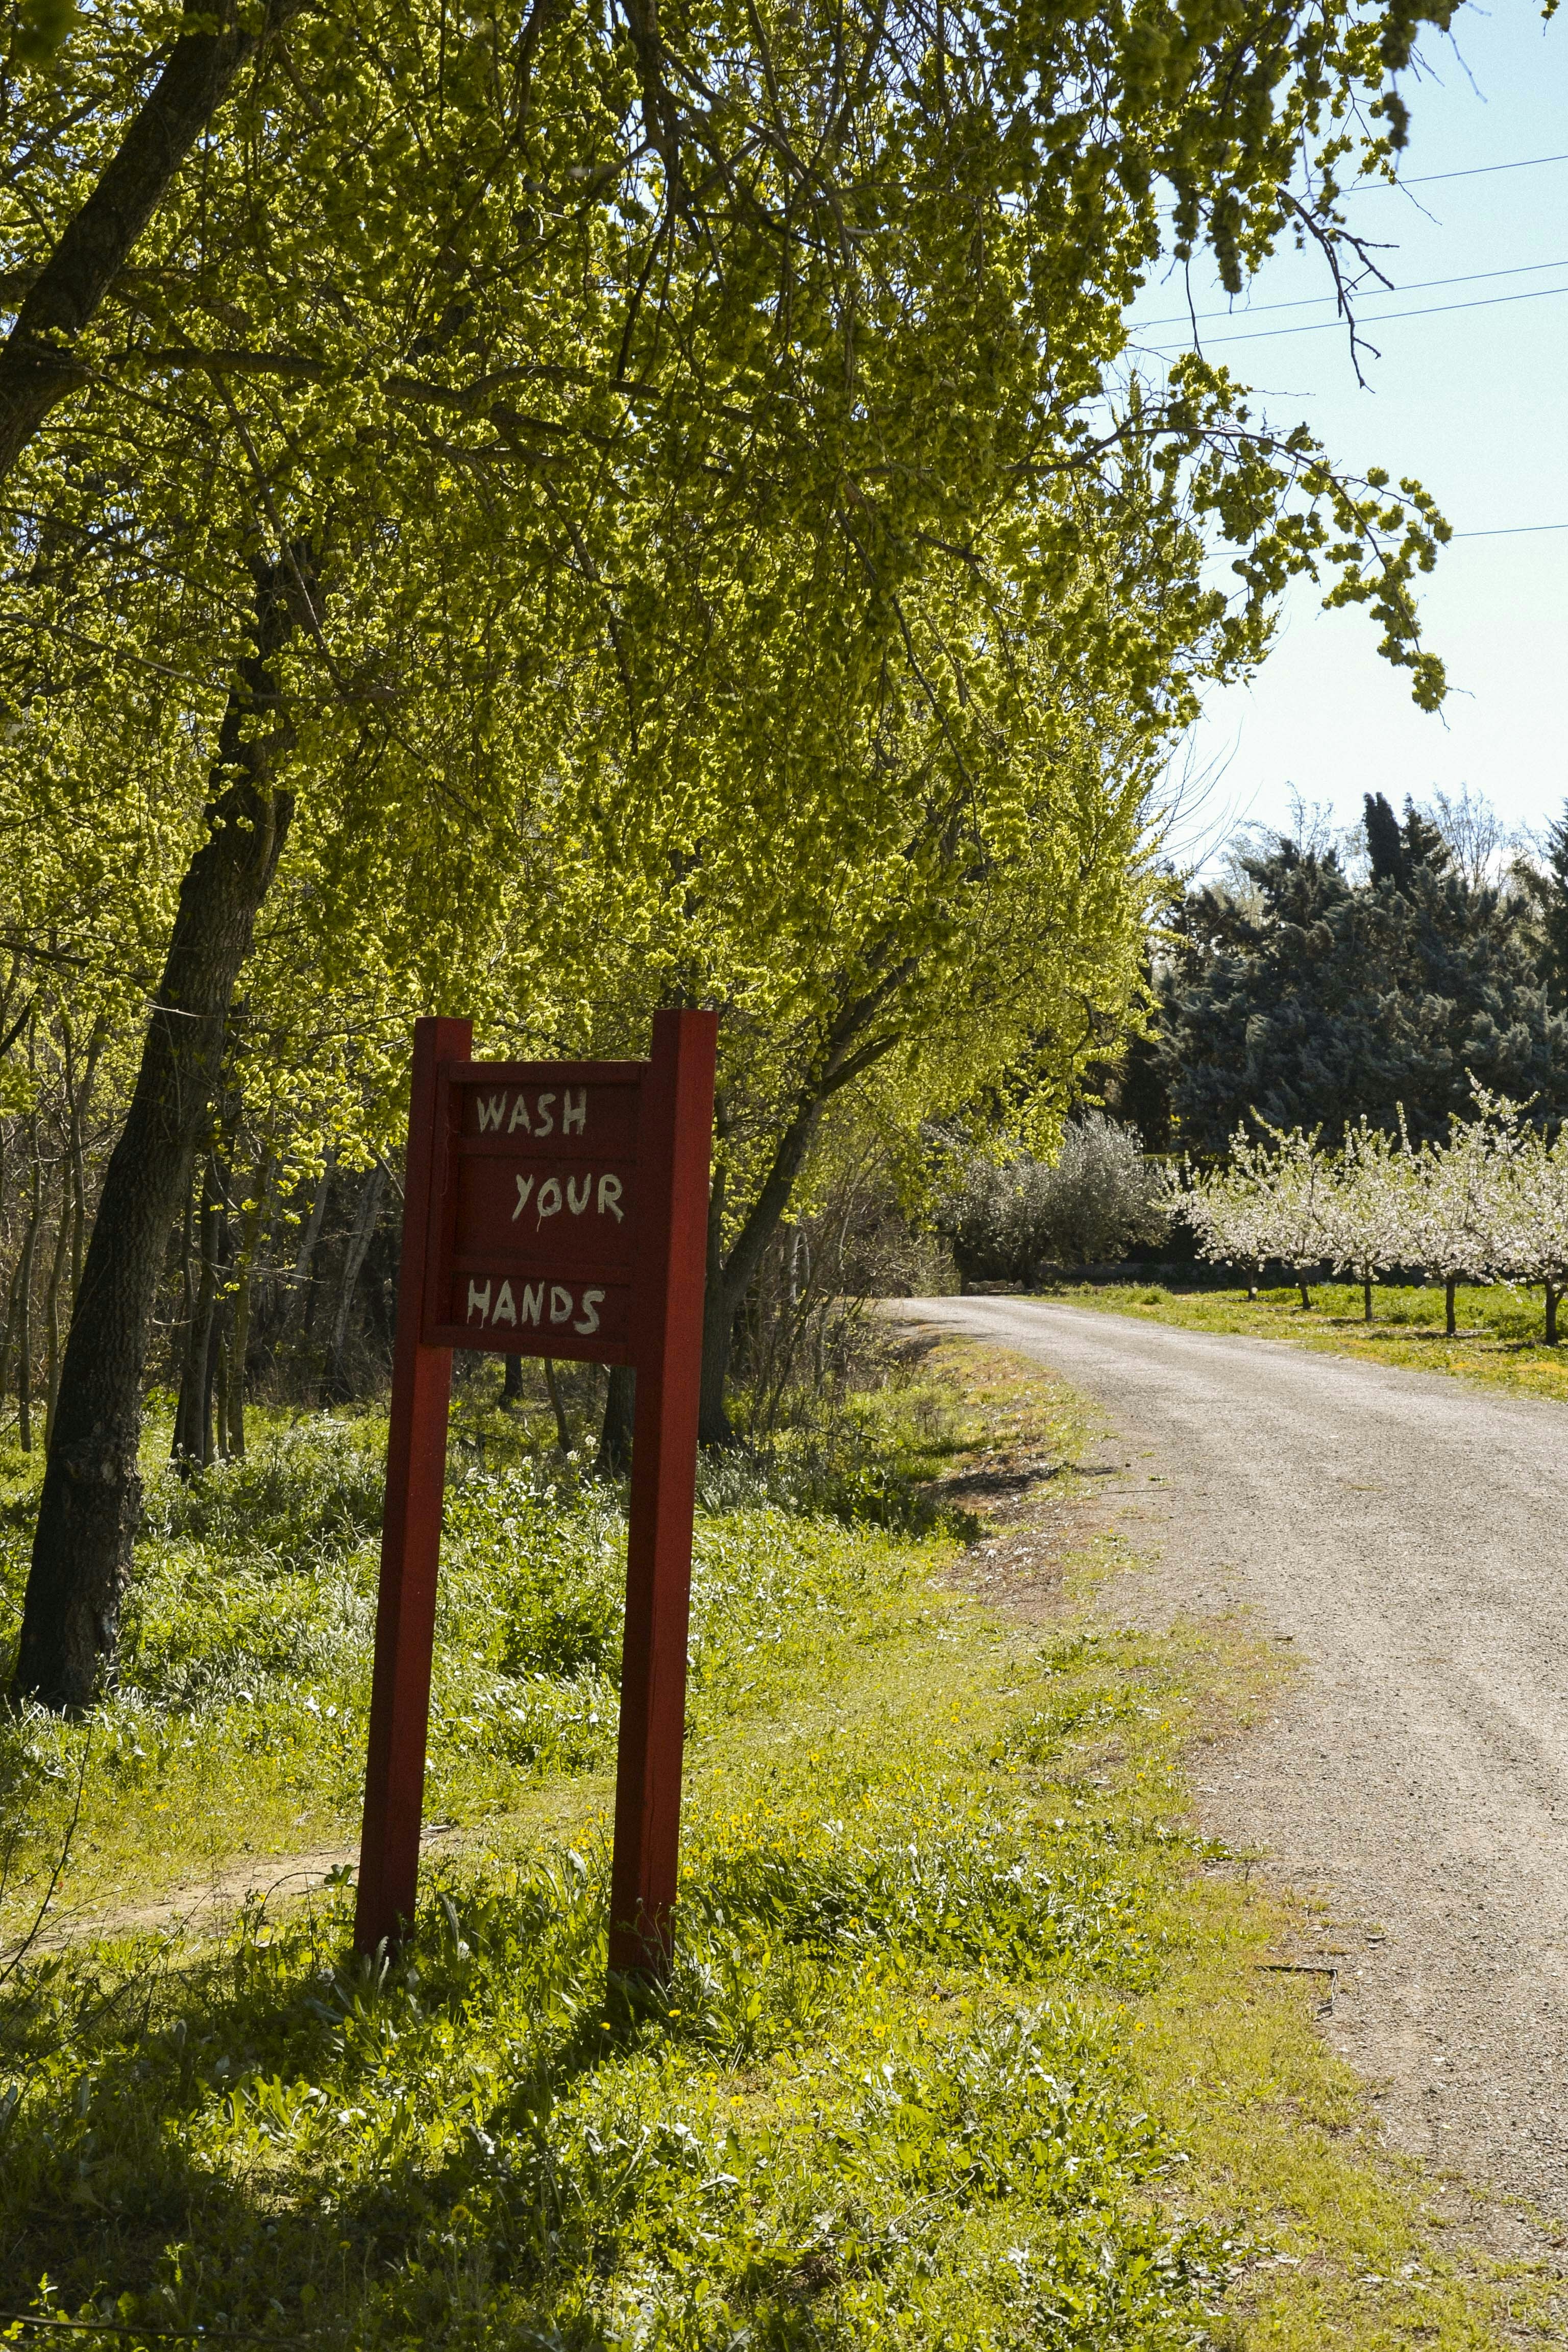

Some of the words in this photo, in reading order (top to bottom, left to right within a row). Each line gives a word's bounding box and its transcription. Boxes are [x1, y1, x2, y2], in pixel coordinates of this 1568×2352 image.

[477, 1089, 586, 1137] WASH
[512, 1173, 623, 1224] YOUR
[467, 1279, 606, 1334] HANDS
